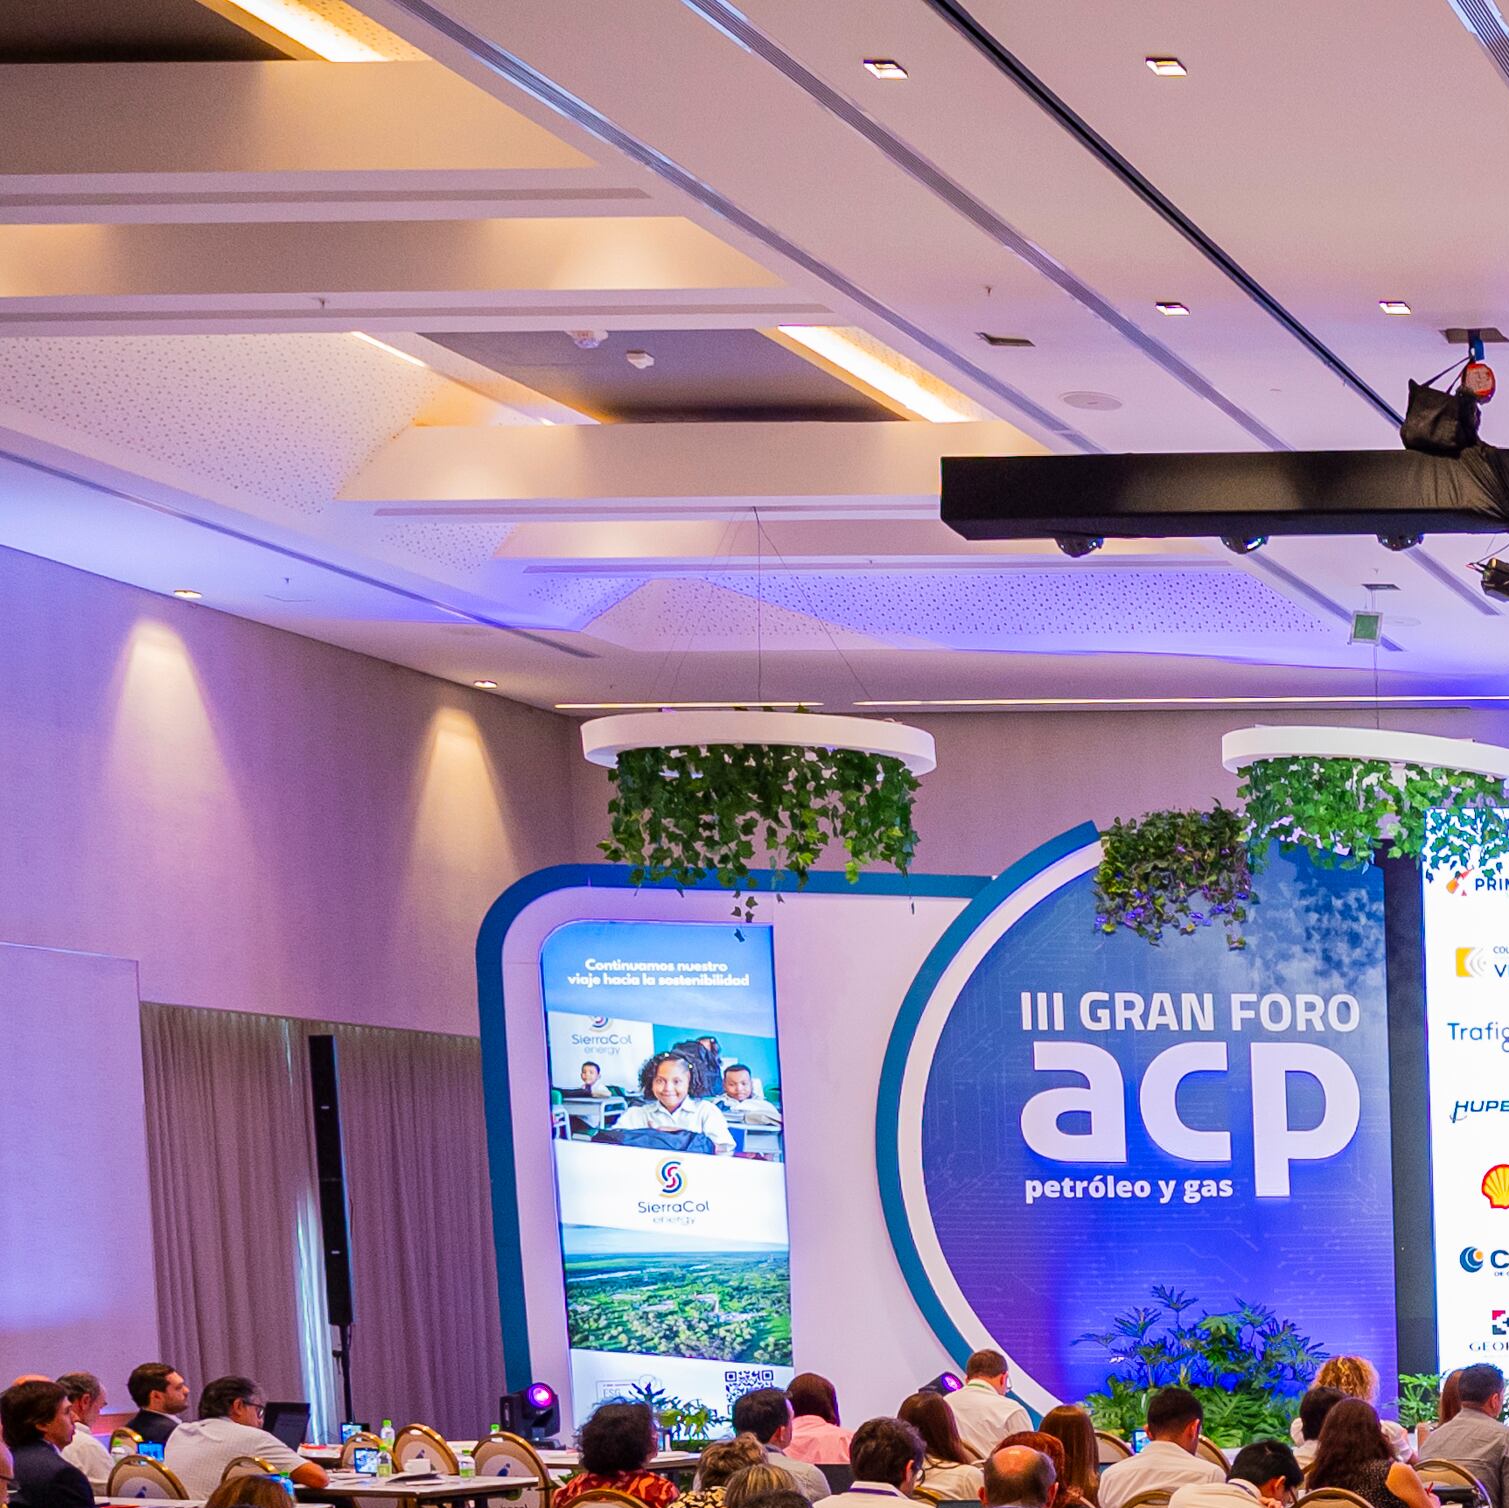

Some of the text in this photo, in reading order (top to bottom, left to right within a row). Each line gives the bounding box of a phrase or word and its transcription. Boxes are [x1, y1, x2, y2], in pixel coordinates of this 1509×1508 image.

[585, 958, 728, 972] Continuamos nuestro
[568, 972, 750, 988] viaje hacia la sostenibilidad
[1020, 991, 1360, 1033] III GRAN FORO
[571, 1034, 632, 1046] SierraCol
[1020, 1040, 1361, 1197] acp
[1025, 1175, 1234, 1204] petróleo y gas
[638, 1200, 710, 1214] SierraCol
